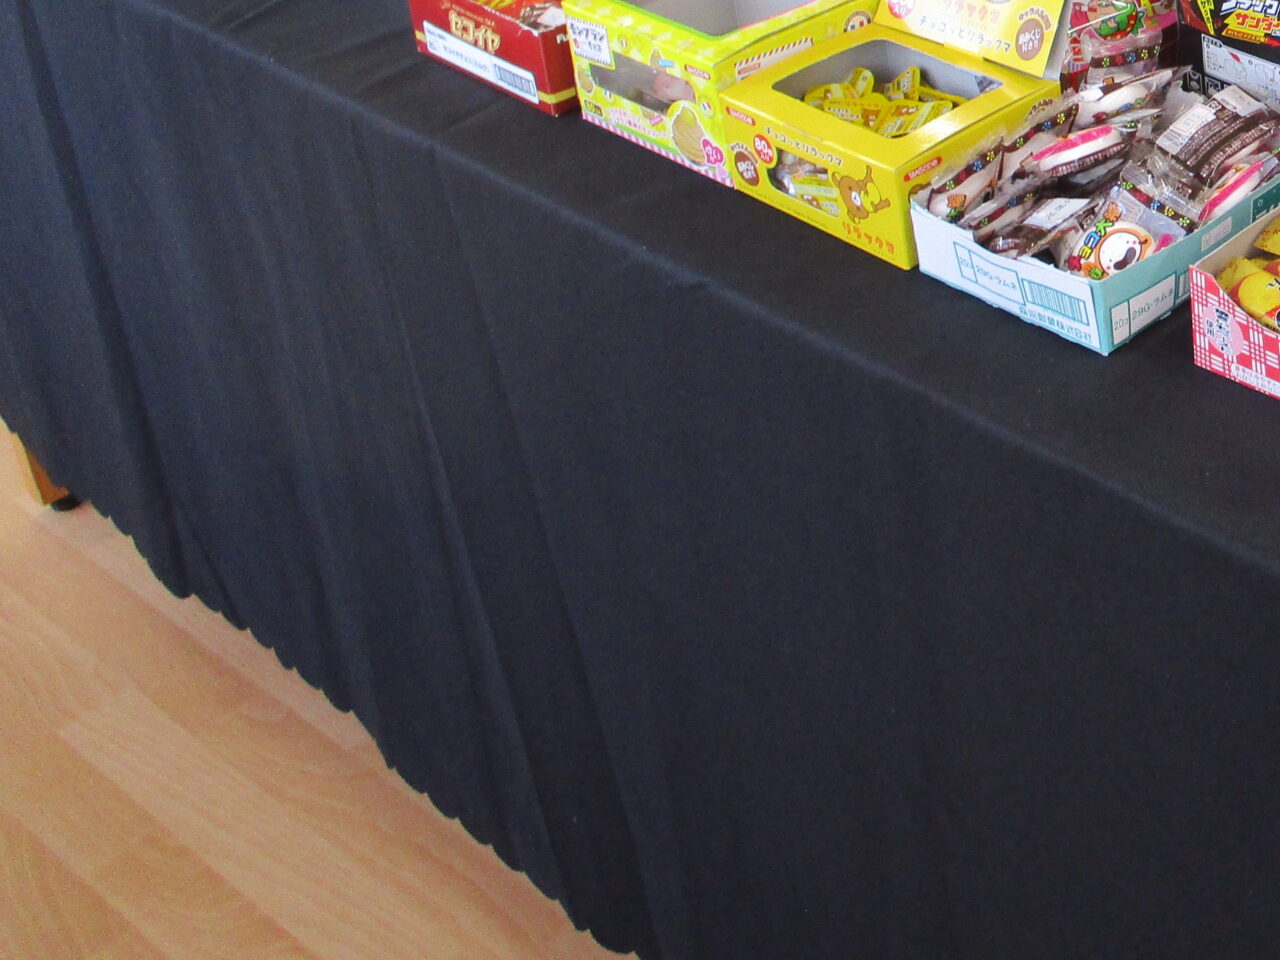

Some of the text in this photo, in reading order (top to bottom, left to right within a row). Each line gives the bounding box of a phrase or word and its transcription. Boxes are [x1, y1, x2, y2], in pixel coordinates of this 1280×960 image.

[919, 15, 1012, 53] チョコっとリラックマ
